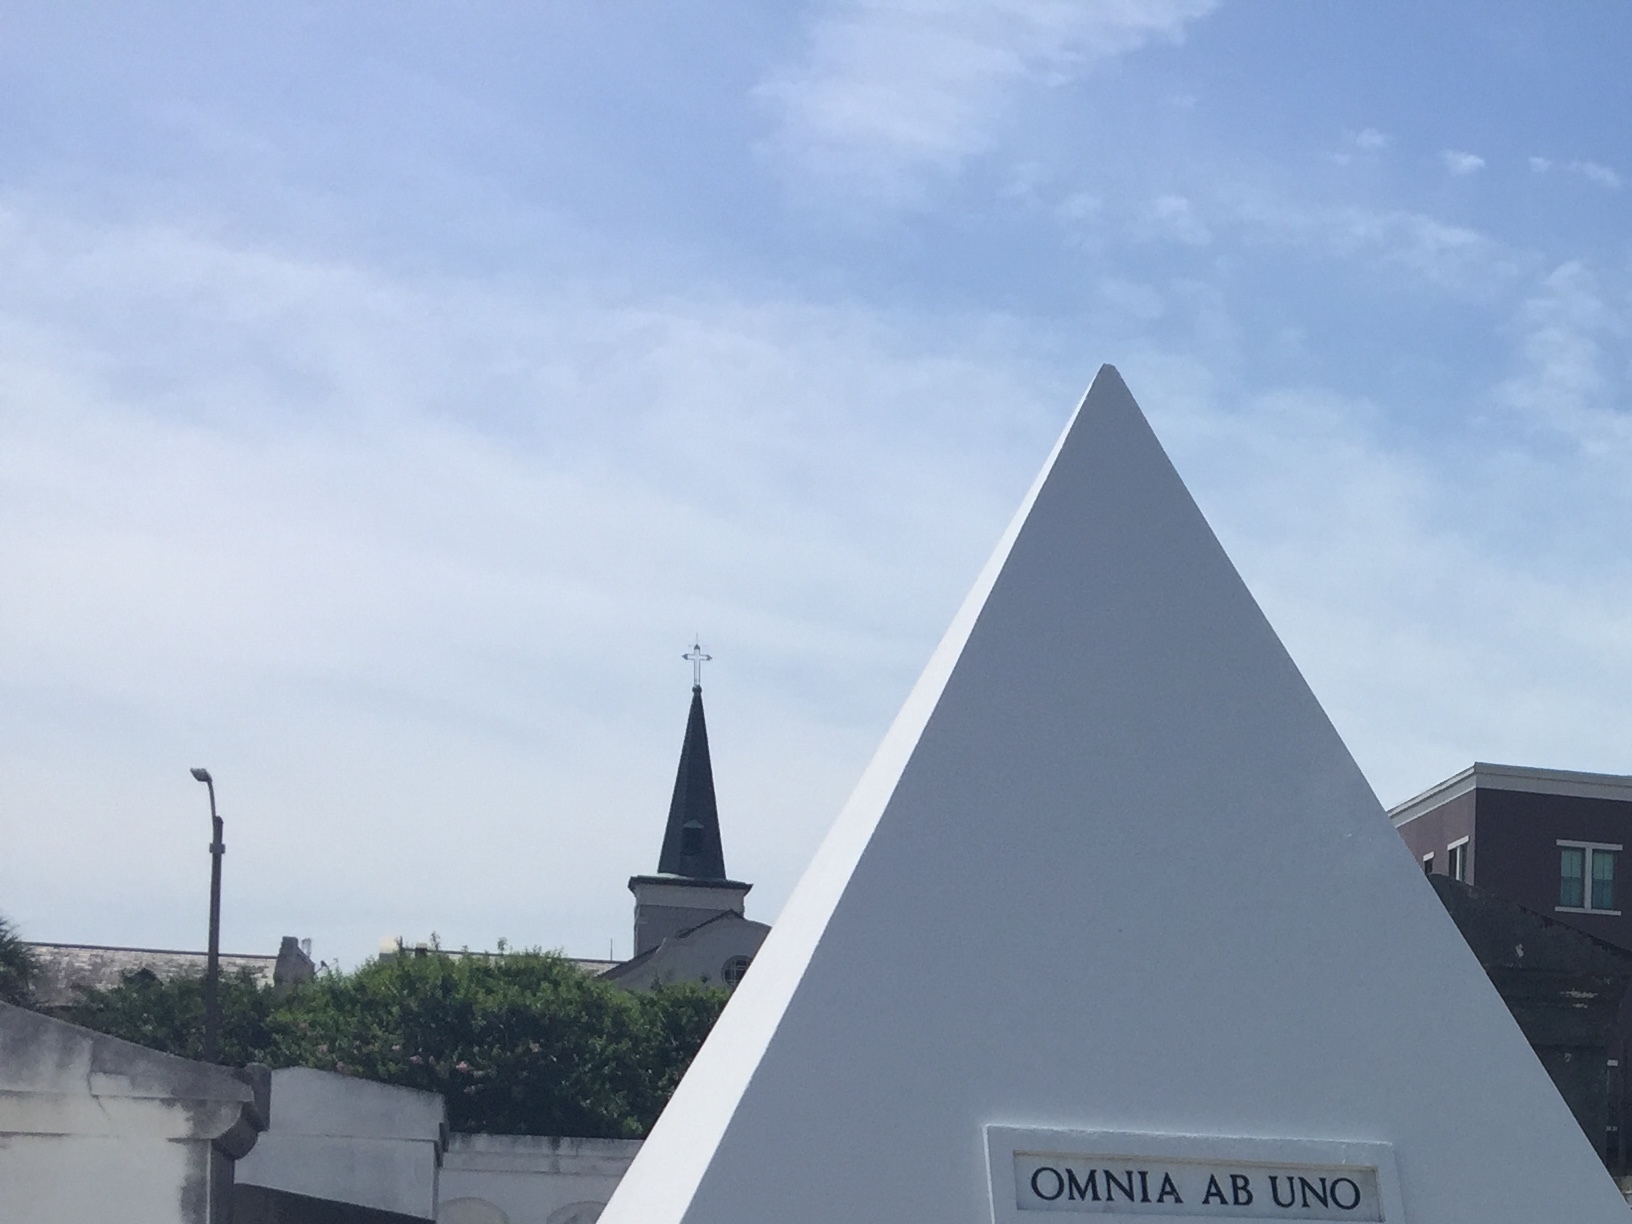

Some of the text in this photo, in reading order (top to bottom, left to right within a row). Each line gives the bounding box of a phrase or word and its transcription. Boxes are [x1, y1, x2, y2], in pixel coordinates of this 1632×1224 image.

[1031, 1166, 1361, 1210] OMNIA AB UNO
